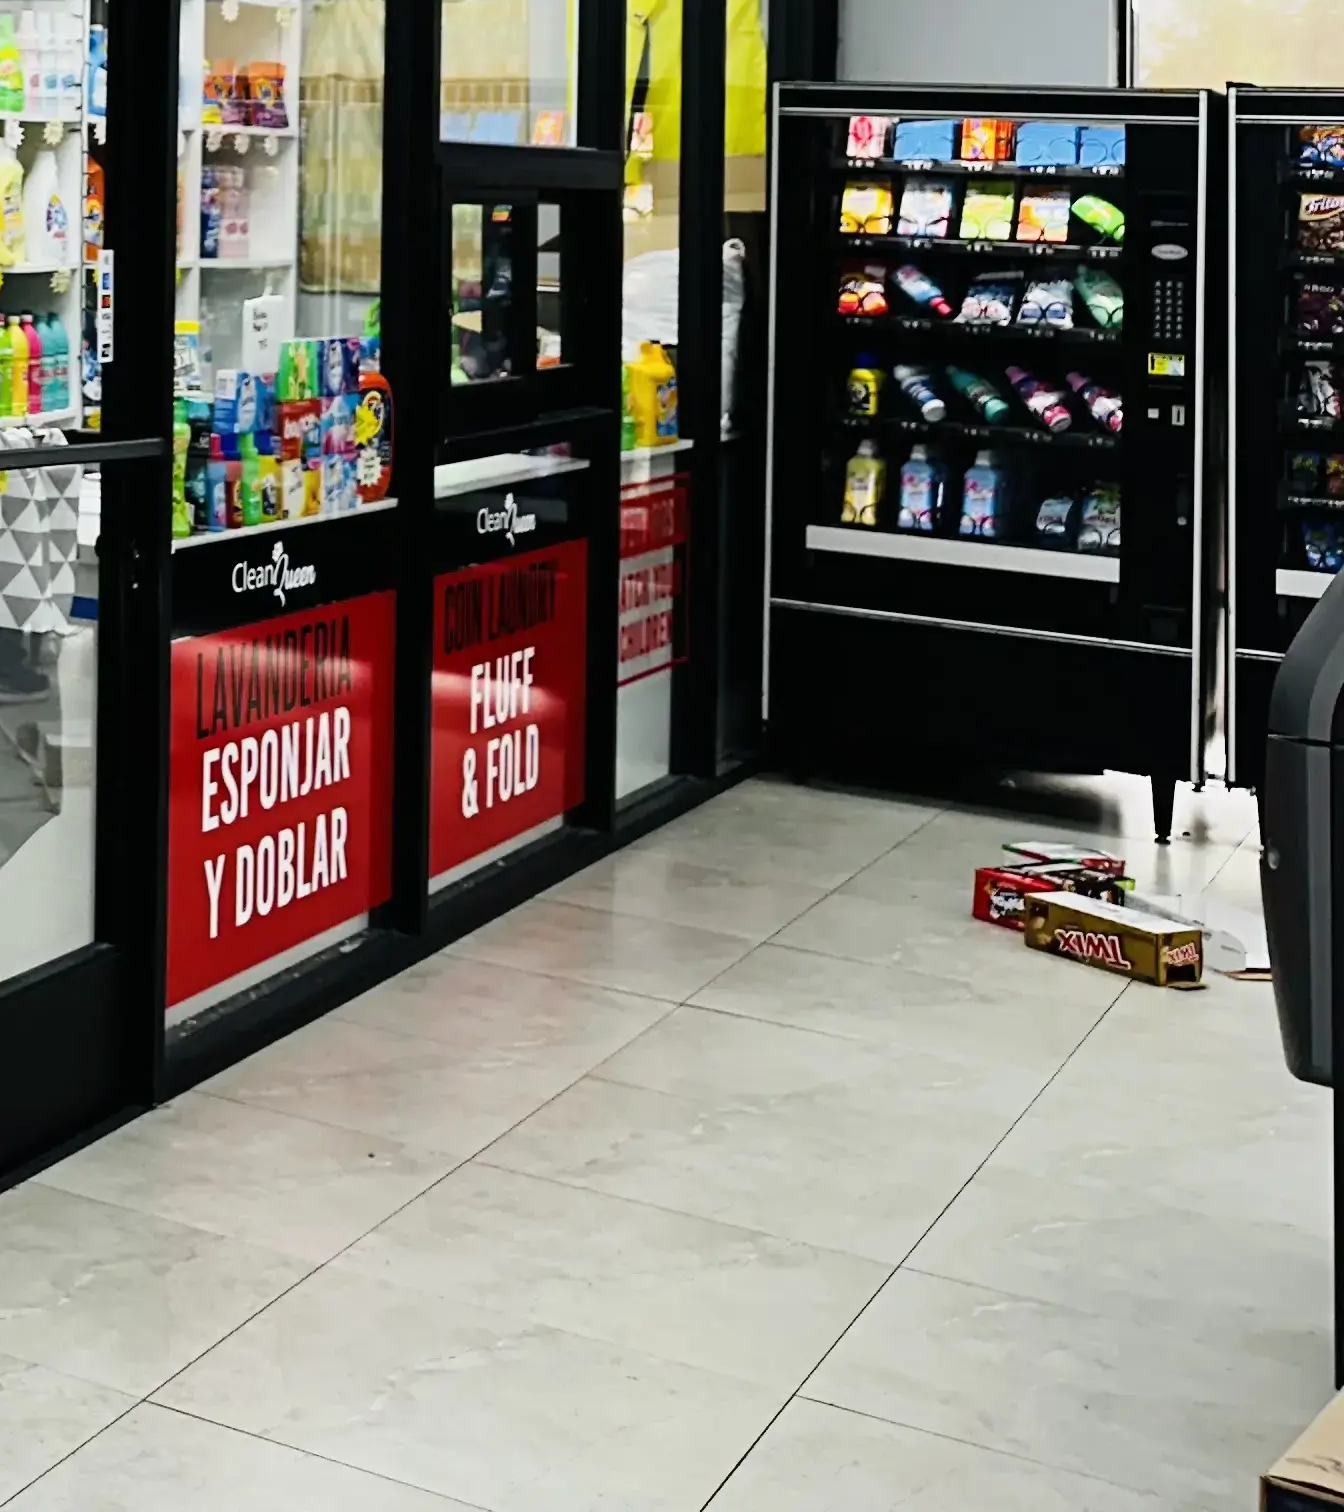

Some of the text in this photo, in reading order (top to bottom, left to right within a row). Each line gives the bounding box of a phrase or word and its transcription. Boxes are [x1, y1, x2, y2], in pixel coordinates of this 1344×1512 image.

[444, 578, 483, 654] COIN
[196, 615, 352, 740] LAVANDERIA
[470, 647, 535, 734] FLUFF
[202, 706, 351, 832] ESPONJAR
[462, 724, 539, 819] & FOLD
[204, 807, 347, 939] Y DOBLAR
[1054, 929, 1131, 970] TWIX
